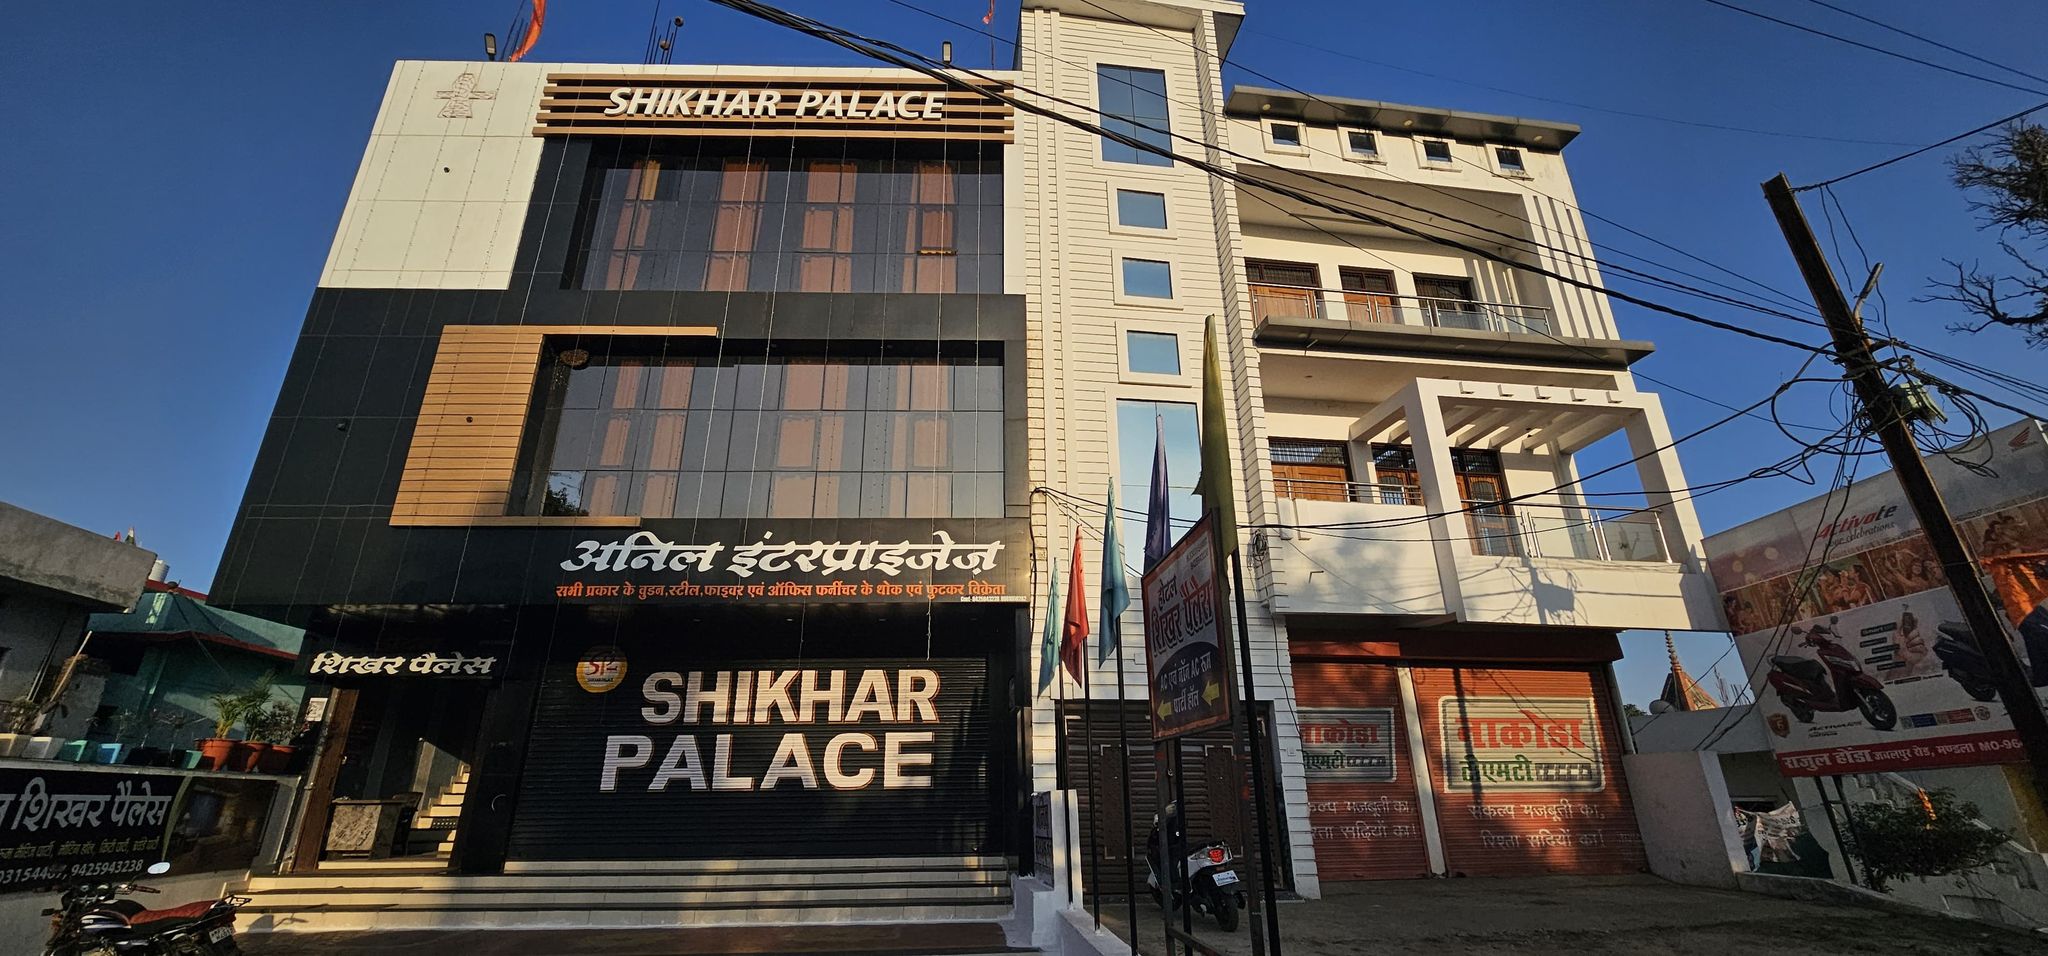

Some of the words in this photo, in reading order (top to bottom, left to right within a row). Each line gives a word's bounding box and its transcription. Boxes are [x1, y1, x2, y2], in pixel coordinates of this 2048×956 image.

[604, 86, 780, 117] SHIKHAR
[796, 91, 946, 120] PALACE
[560, 531, 724, 572] अनिल
[726, 530, 1006, 577] इंटरप्राइजेज़
[556, 582, 584, 597] सभी
[586, 585, 619, 598] प्रकार
[622, 581, 635, 597] के
[747, 582, 765, 597] एवं
[768, 581, 812, 597] ऑफिस
[816, 580, 857, 597] फर्नीचर
[861, 580, 873, 597] के
[876, 581, 902, 597] थोक
[906, 582, 923, 597] एवं
[926, 583, 964, 600] फुटकर
[968, 580, 1006, 597] विक्रेता
[310, 651, 406, 675] शिखर
[408, 652, 497, 675] पैलेस
[641, 669, 942, 725] SHIKHAR
[1979, 738, 2024, 752] MO-96
[600, 732, 935, 792] PALACE
[1459, 754, 1534, 783] टीएमटी
[11, 777, 112, 831] शिखर
[111, 780, 173, 827] पैलेस
[71, 860, 144, 877] 9425943238
